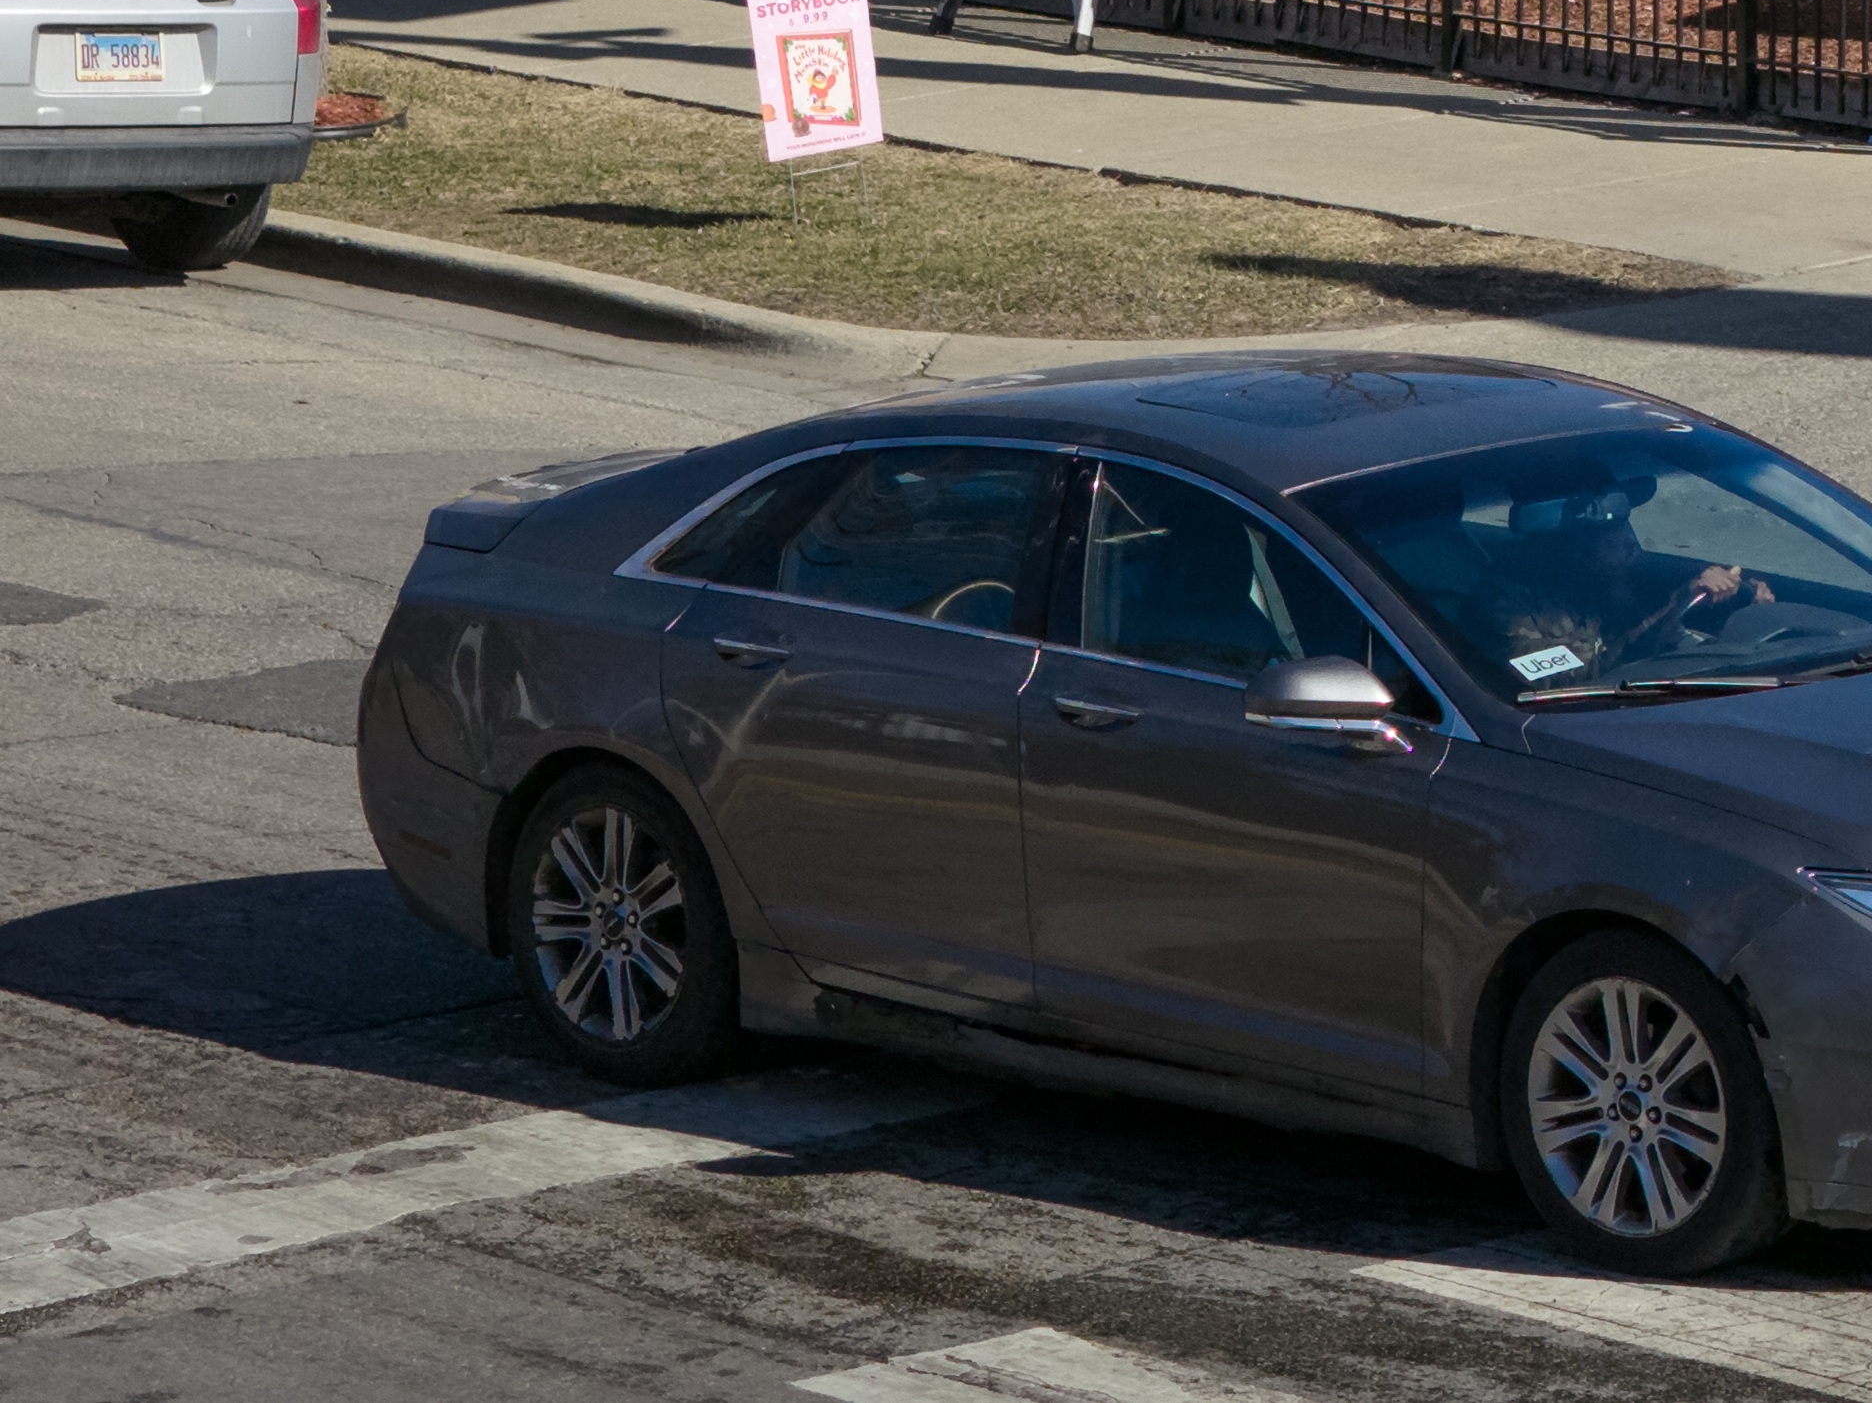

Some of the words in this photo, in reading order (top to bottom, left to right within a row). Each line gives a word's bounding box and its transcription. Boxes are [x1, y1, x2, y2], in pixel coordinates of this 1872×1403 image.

[81, 43, 100, 69] DR
[110, 43, 160, 69] 58834
[1520, 654, 1571, 673] Uber
